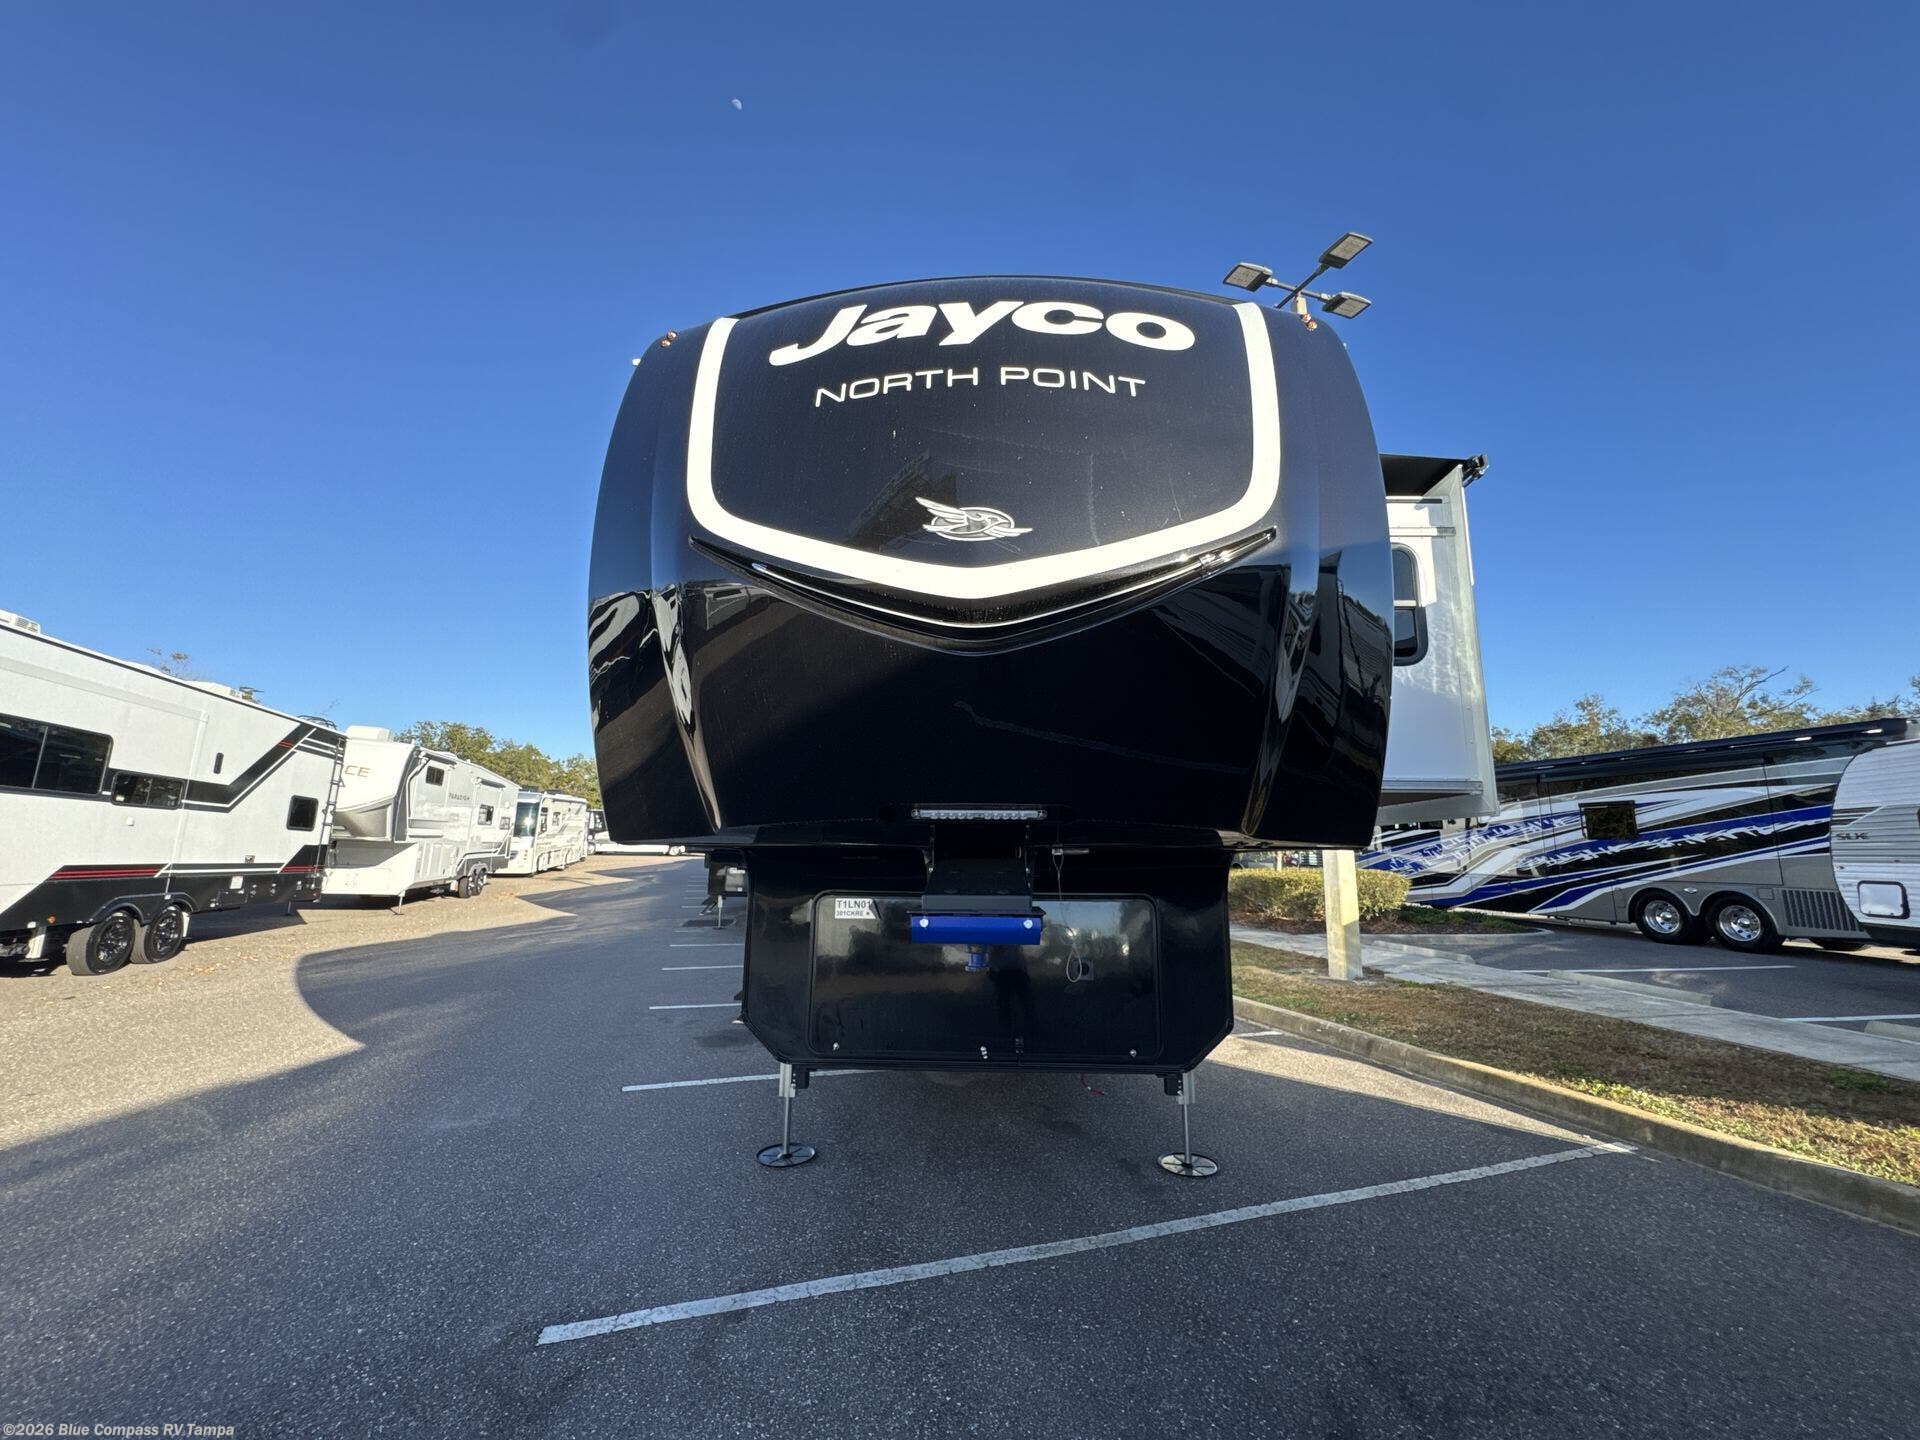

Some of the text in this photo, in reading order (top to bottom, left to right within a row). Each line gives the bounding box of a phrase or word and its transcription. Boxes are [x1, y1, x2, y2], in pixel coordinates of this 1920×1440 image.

[769, 301, 1196, 366] Jayco
[815, 367, 1145, 407] NORTH POINT
[344, 764, 371, 778] CE
